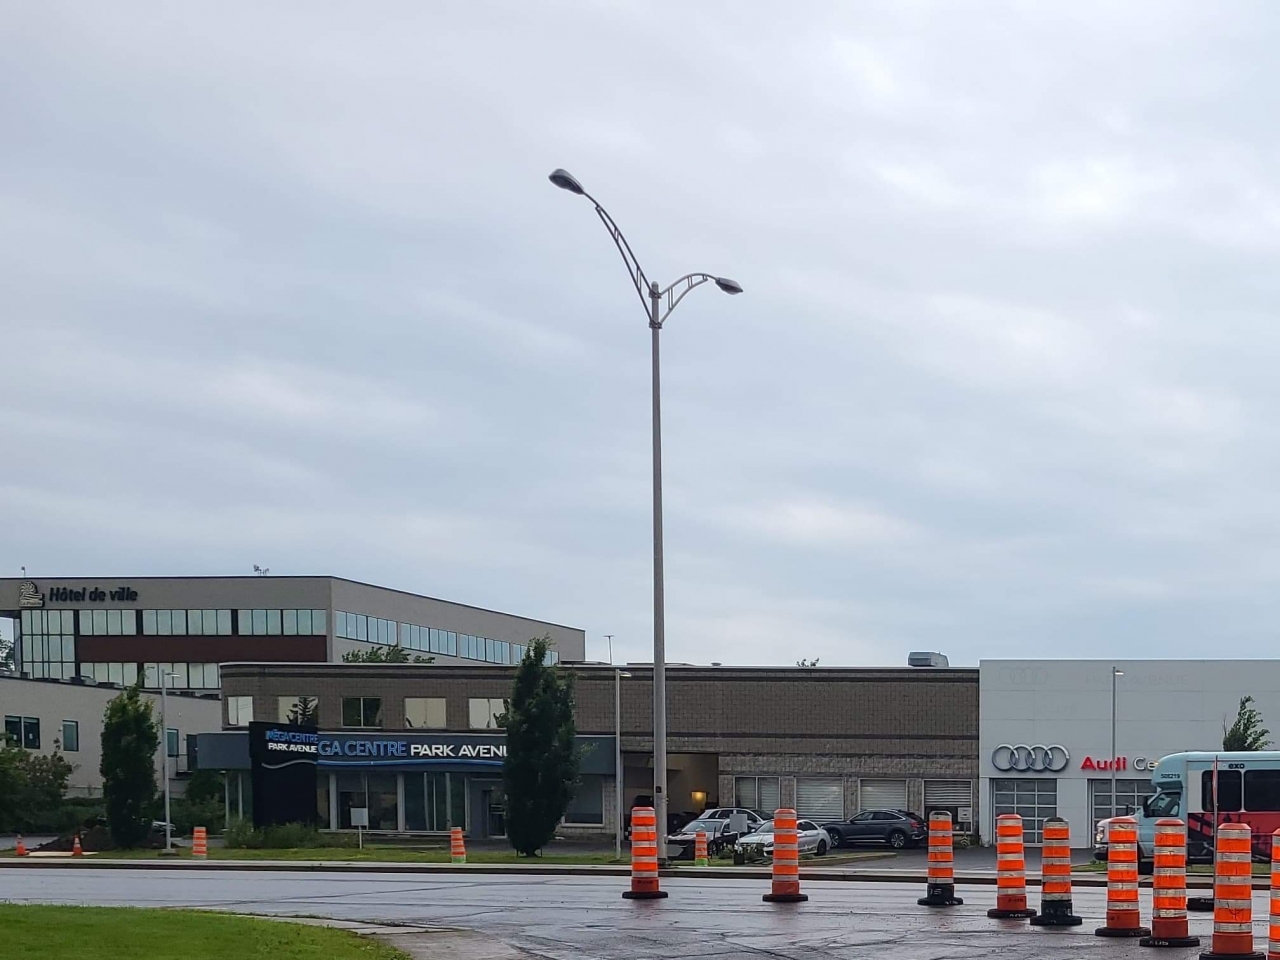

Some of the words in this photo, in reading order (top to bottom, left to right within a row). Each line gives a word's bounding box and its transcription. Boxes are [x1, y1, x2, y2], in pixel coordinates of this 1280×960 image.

[49, 587, 86, 601] Hôtel
[89, 587, 106, 601] de
[109, 586, 138, 601] ville
[268, 742, 288, 751] PARK
[289, 744, 318, 753] AVENUE
[318, 740, 343, 756] GA
[344, 740, 407, 756] CENTRE
[410, 744, 454, 757] PARK
[458, 744, 508, 757] AVEN
[1081, 756, 1128, 770] Audi
[1132, 757, 1156, 771] Ce
